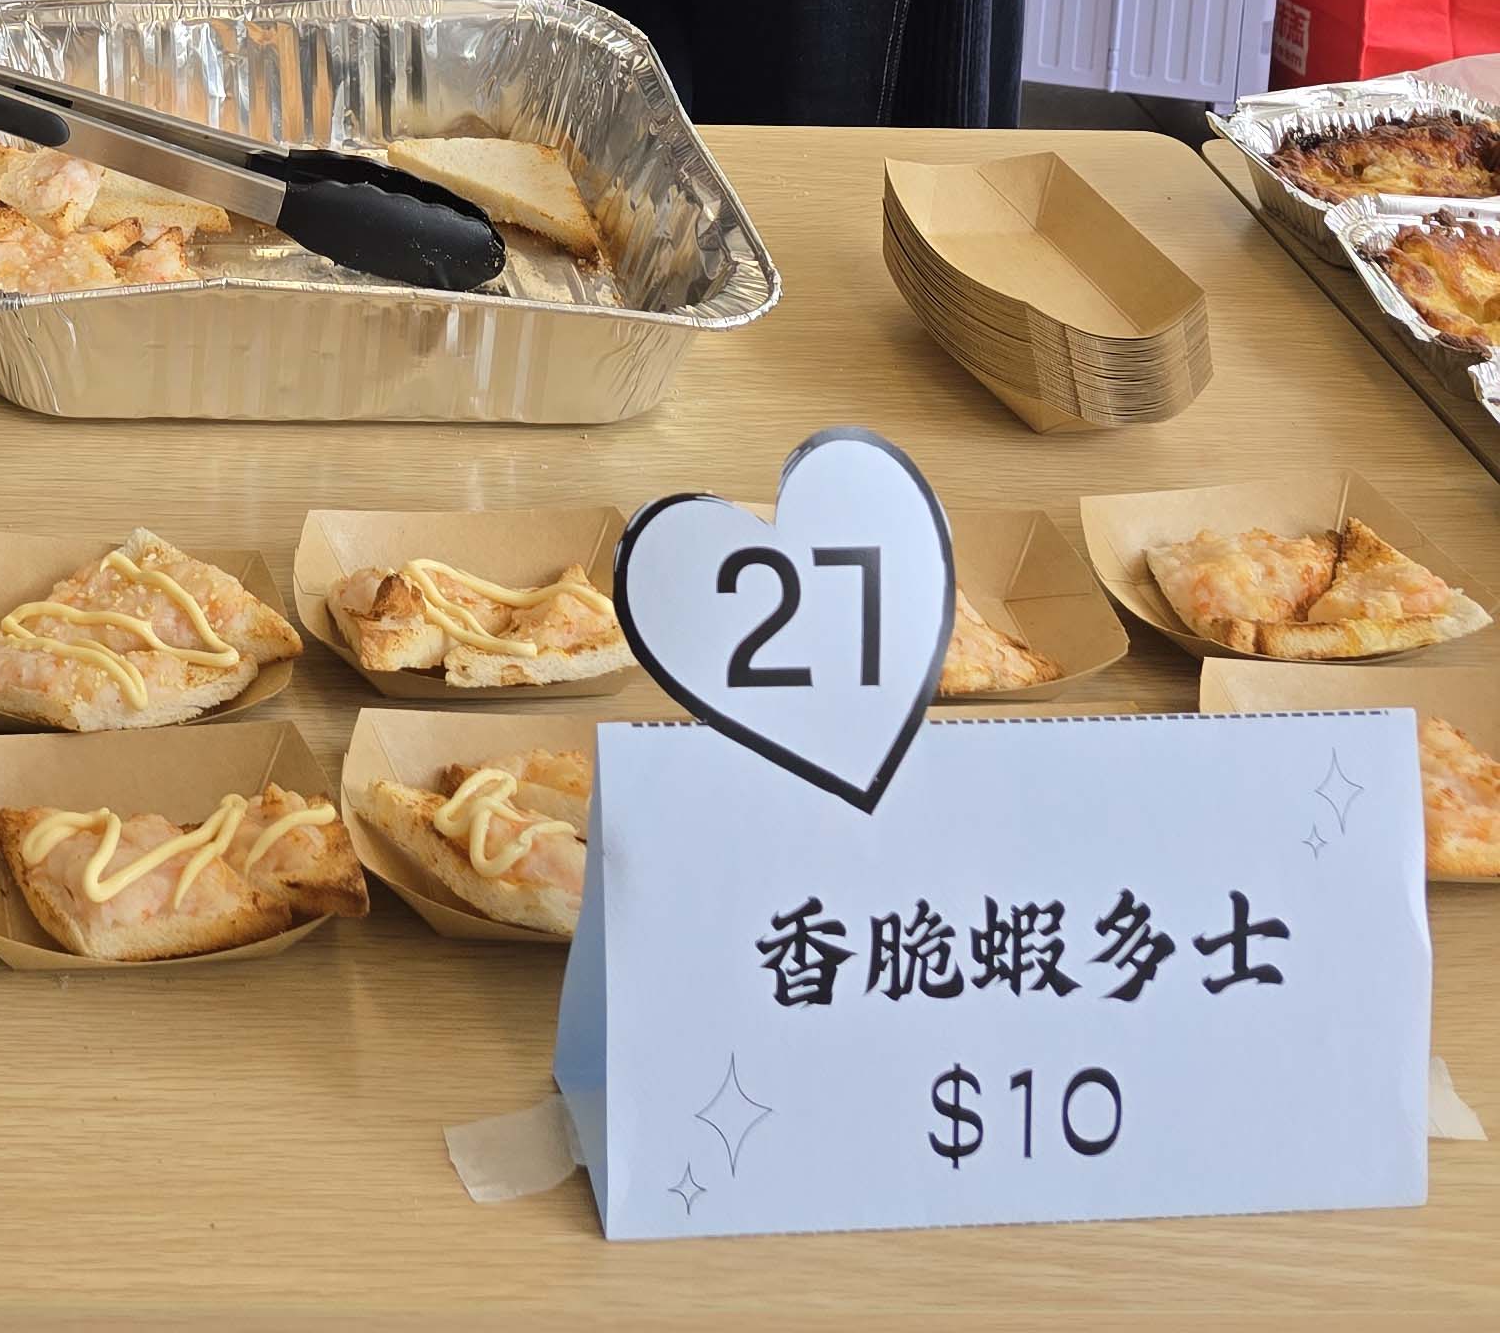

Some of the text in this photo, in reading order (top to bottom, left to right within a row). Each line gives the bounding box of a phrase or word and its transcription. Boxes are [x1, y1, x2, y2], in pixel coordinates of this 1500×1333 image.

[715, 545, 883, 689] 27
[756, 887, 1292, 1008] 香脆蝦多士
[928, 1063, 1125, 1170] $10
